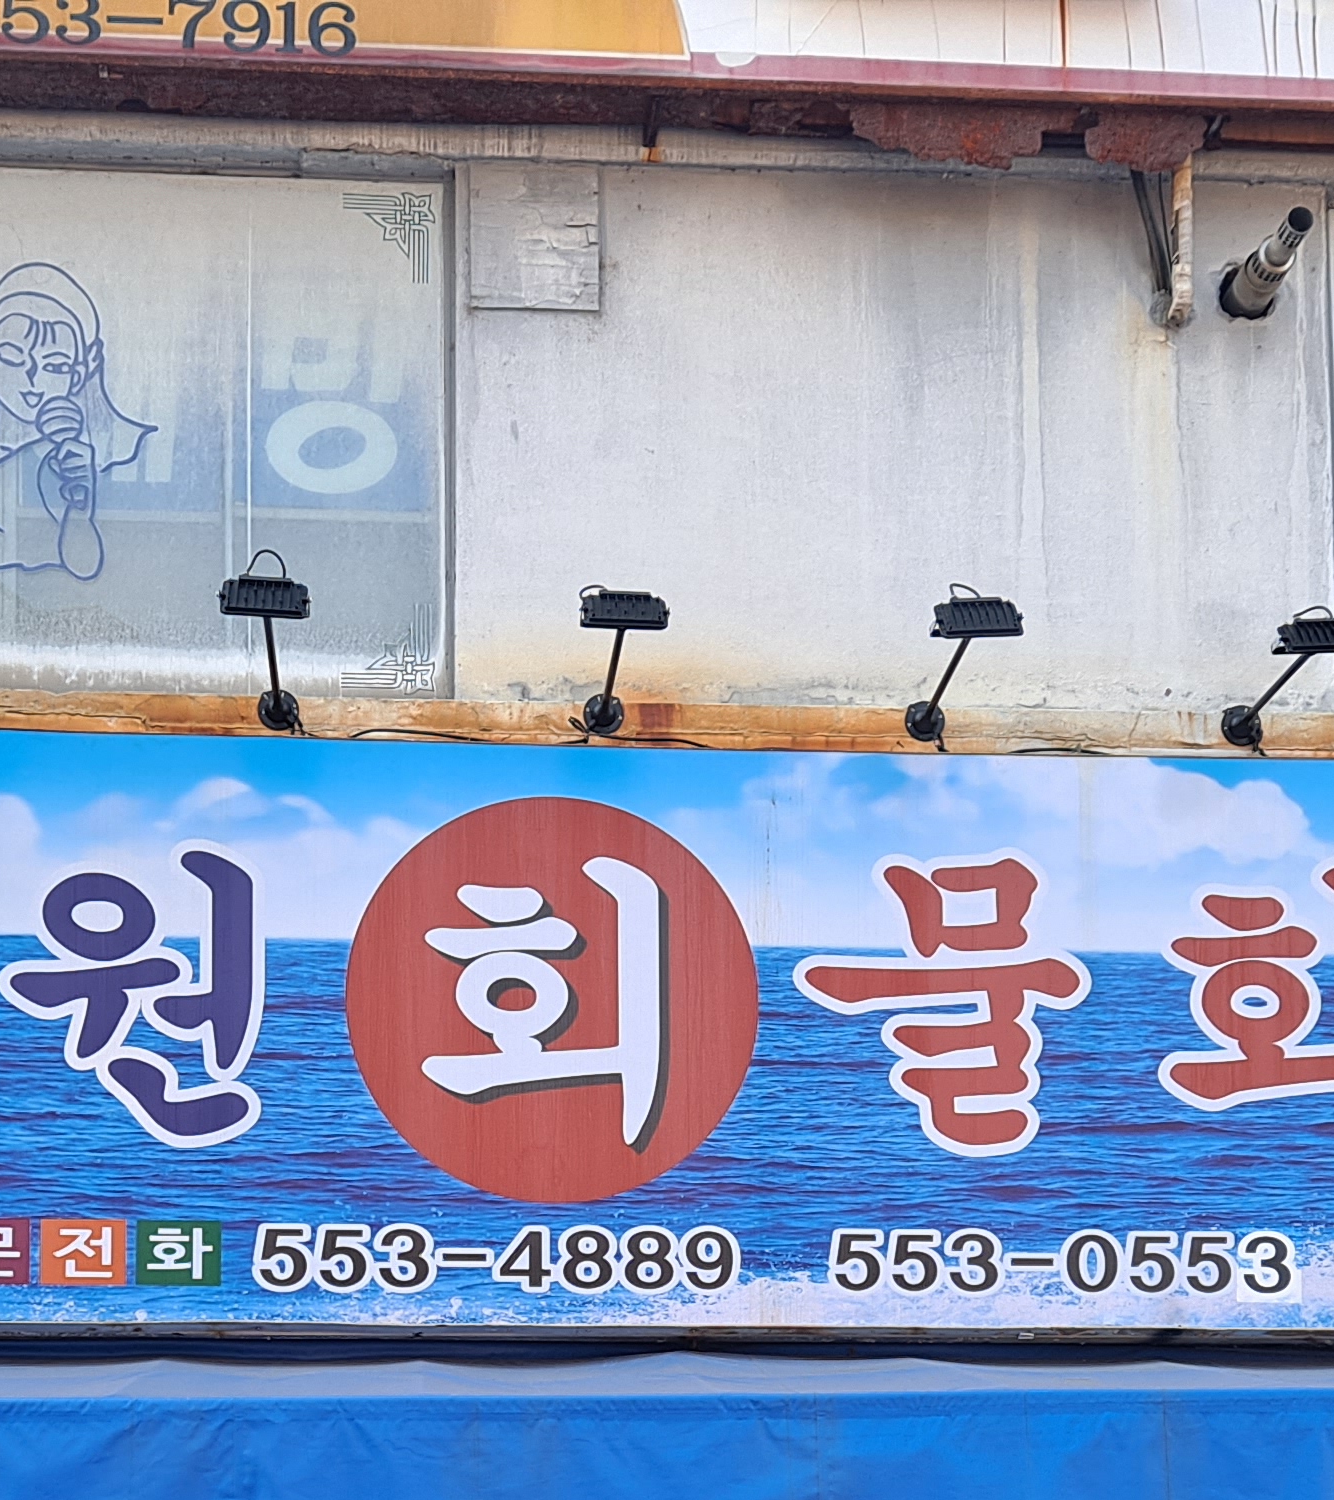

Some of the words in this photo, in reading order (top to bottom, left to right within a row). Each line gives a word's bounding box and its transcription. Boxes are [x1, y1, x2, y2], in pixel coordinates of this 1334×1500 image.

[421, 856, 667, 1154] 회
[255, 1225, 739, 1293] 553-4889
[831, 1229, 1295, 1295] 553-0553
